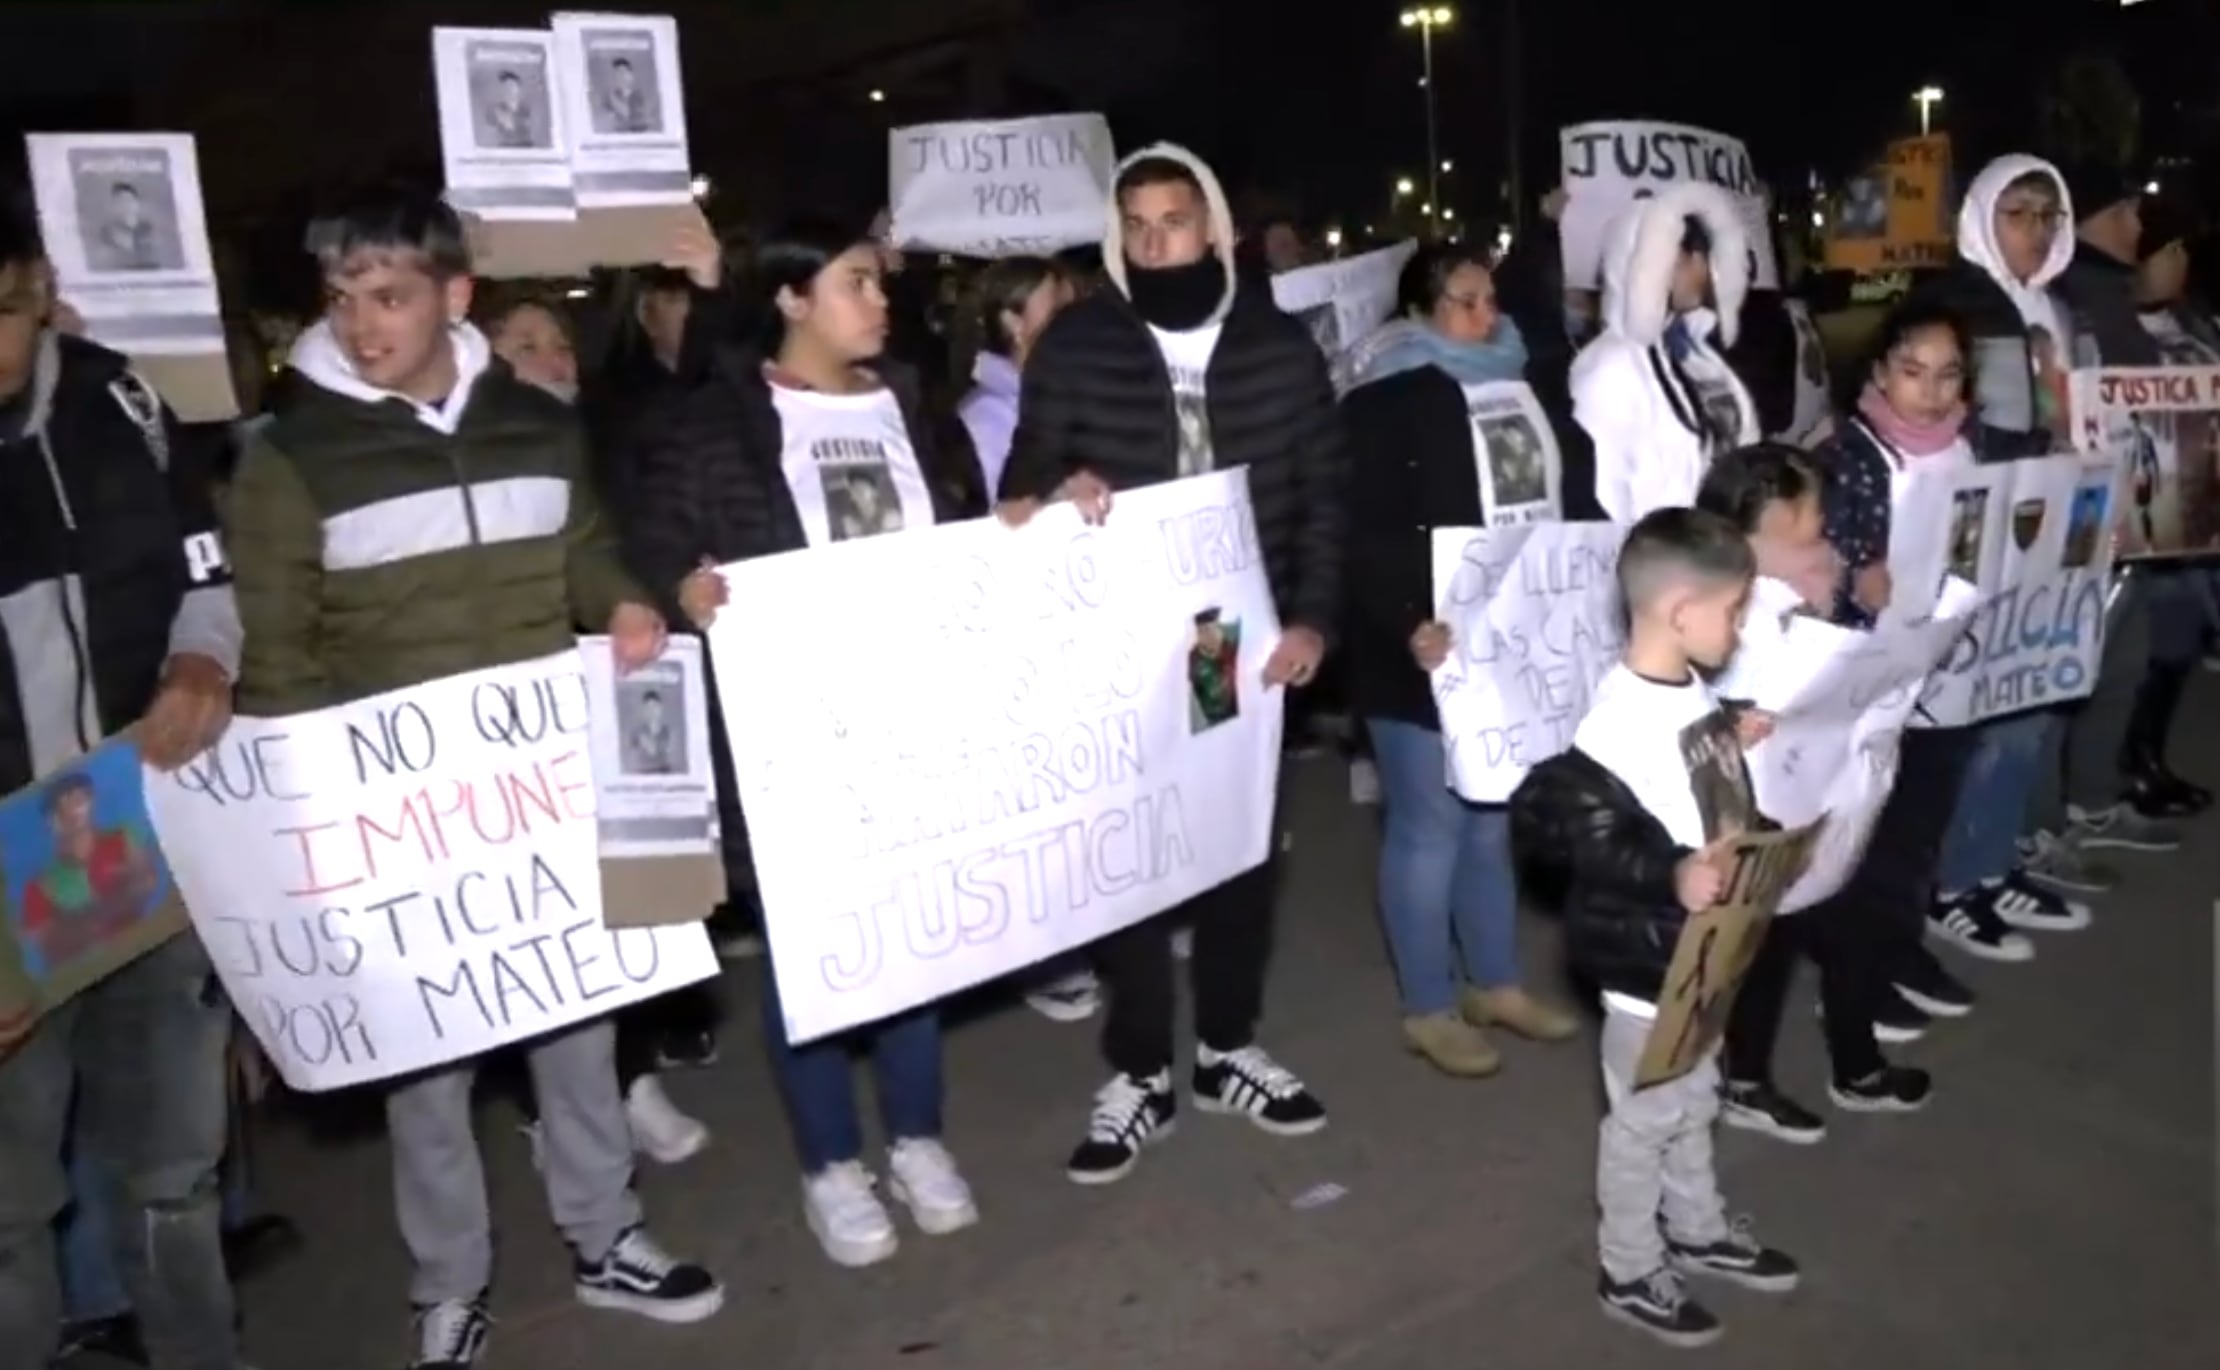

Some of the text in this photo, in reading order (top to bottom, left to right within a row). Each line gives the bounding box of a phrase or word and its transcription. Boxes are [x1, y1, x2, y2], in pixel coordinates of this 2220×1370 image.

[344, 699, 436, 785] NO
[272, 749, 596, 898] IMPUNE
[818, 782, 1196, 994] JUSTICIA
[213, 852, 578, 978] JUSTICIA
